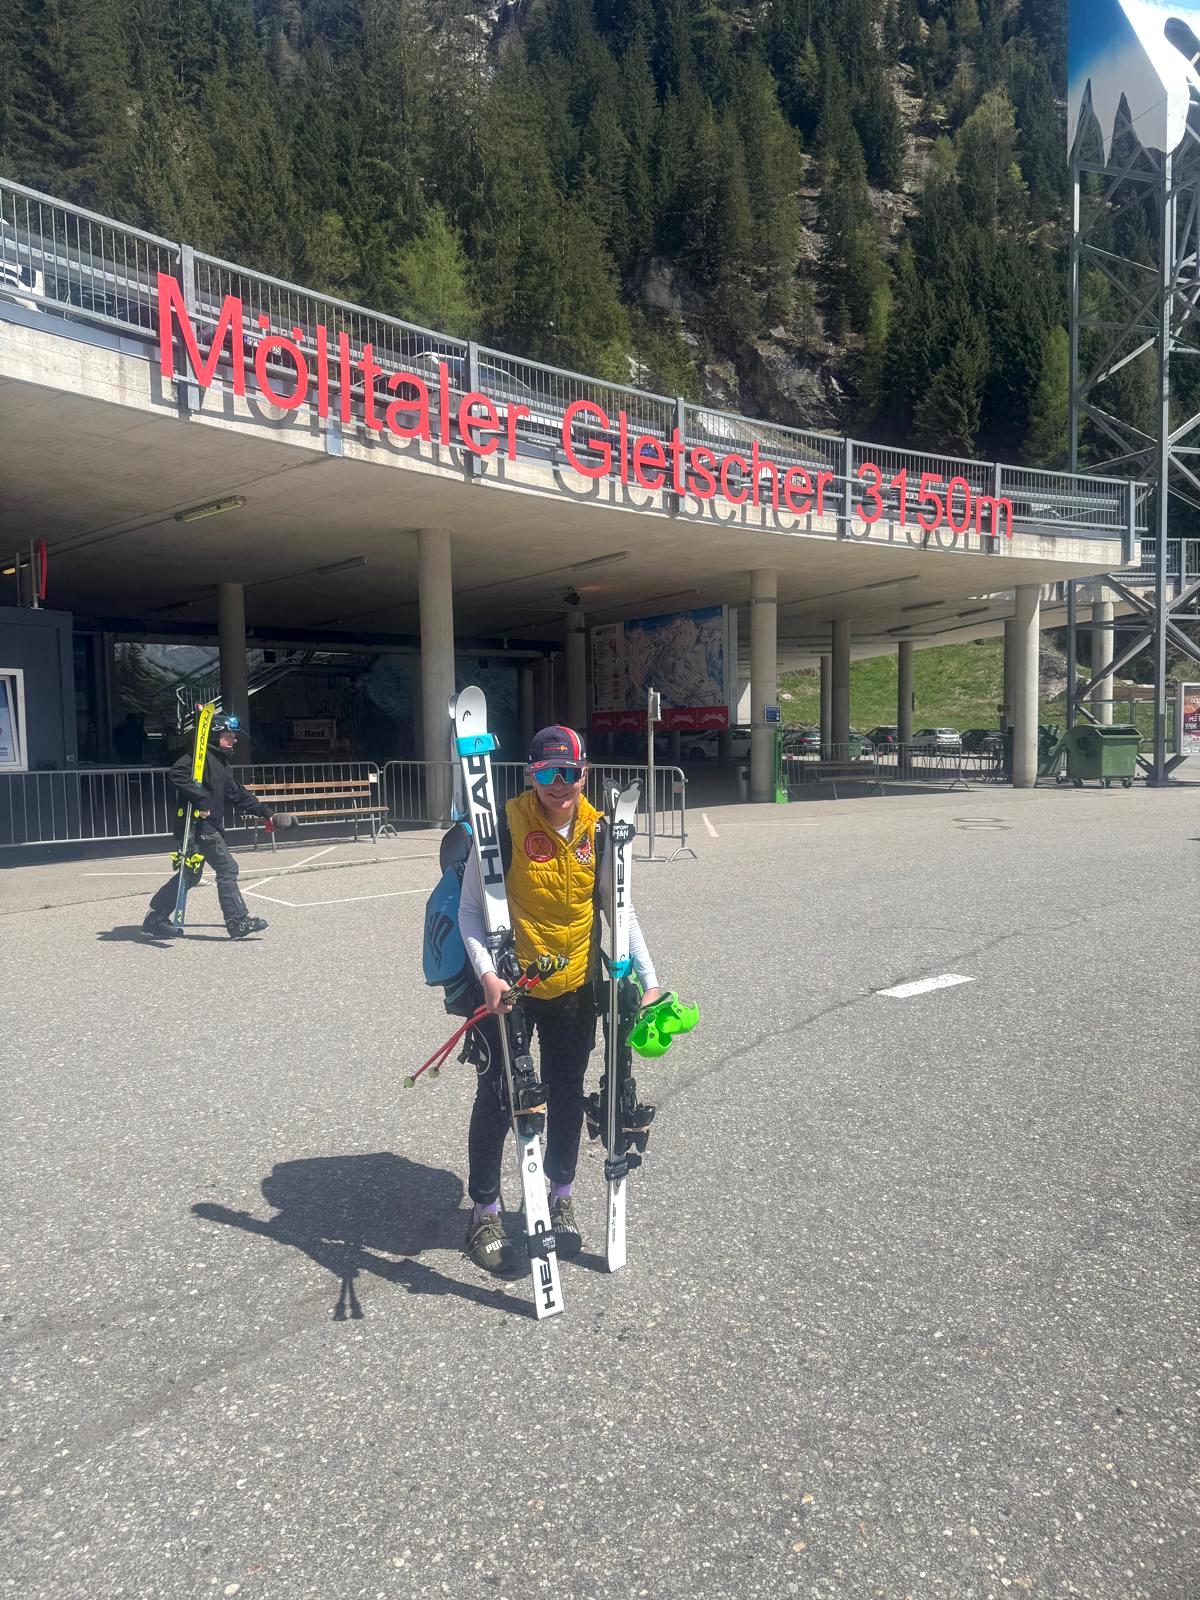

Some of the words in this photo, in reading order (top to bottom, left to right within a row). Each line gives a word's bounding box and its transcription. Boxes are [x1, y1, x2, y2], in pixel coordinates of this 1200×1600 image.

[158, 272, 529, 459] Mölltaler
[563, 401, 832, 515] Gletscher
[857, 464, 1012, 536] 3150m
[616, 819, 625, 908] HEA
